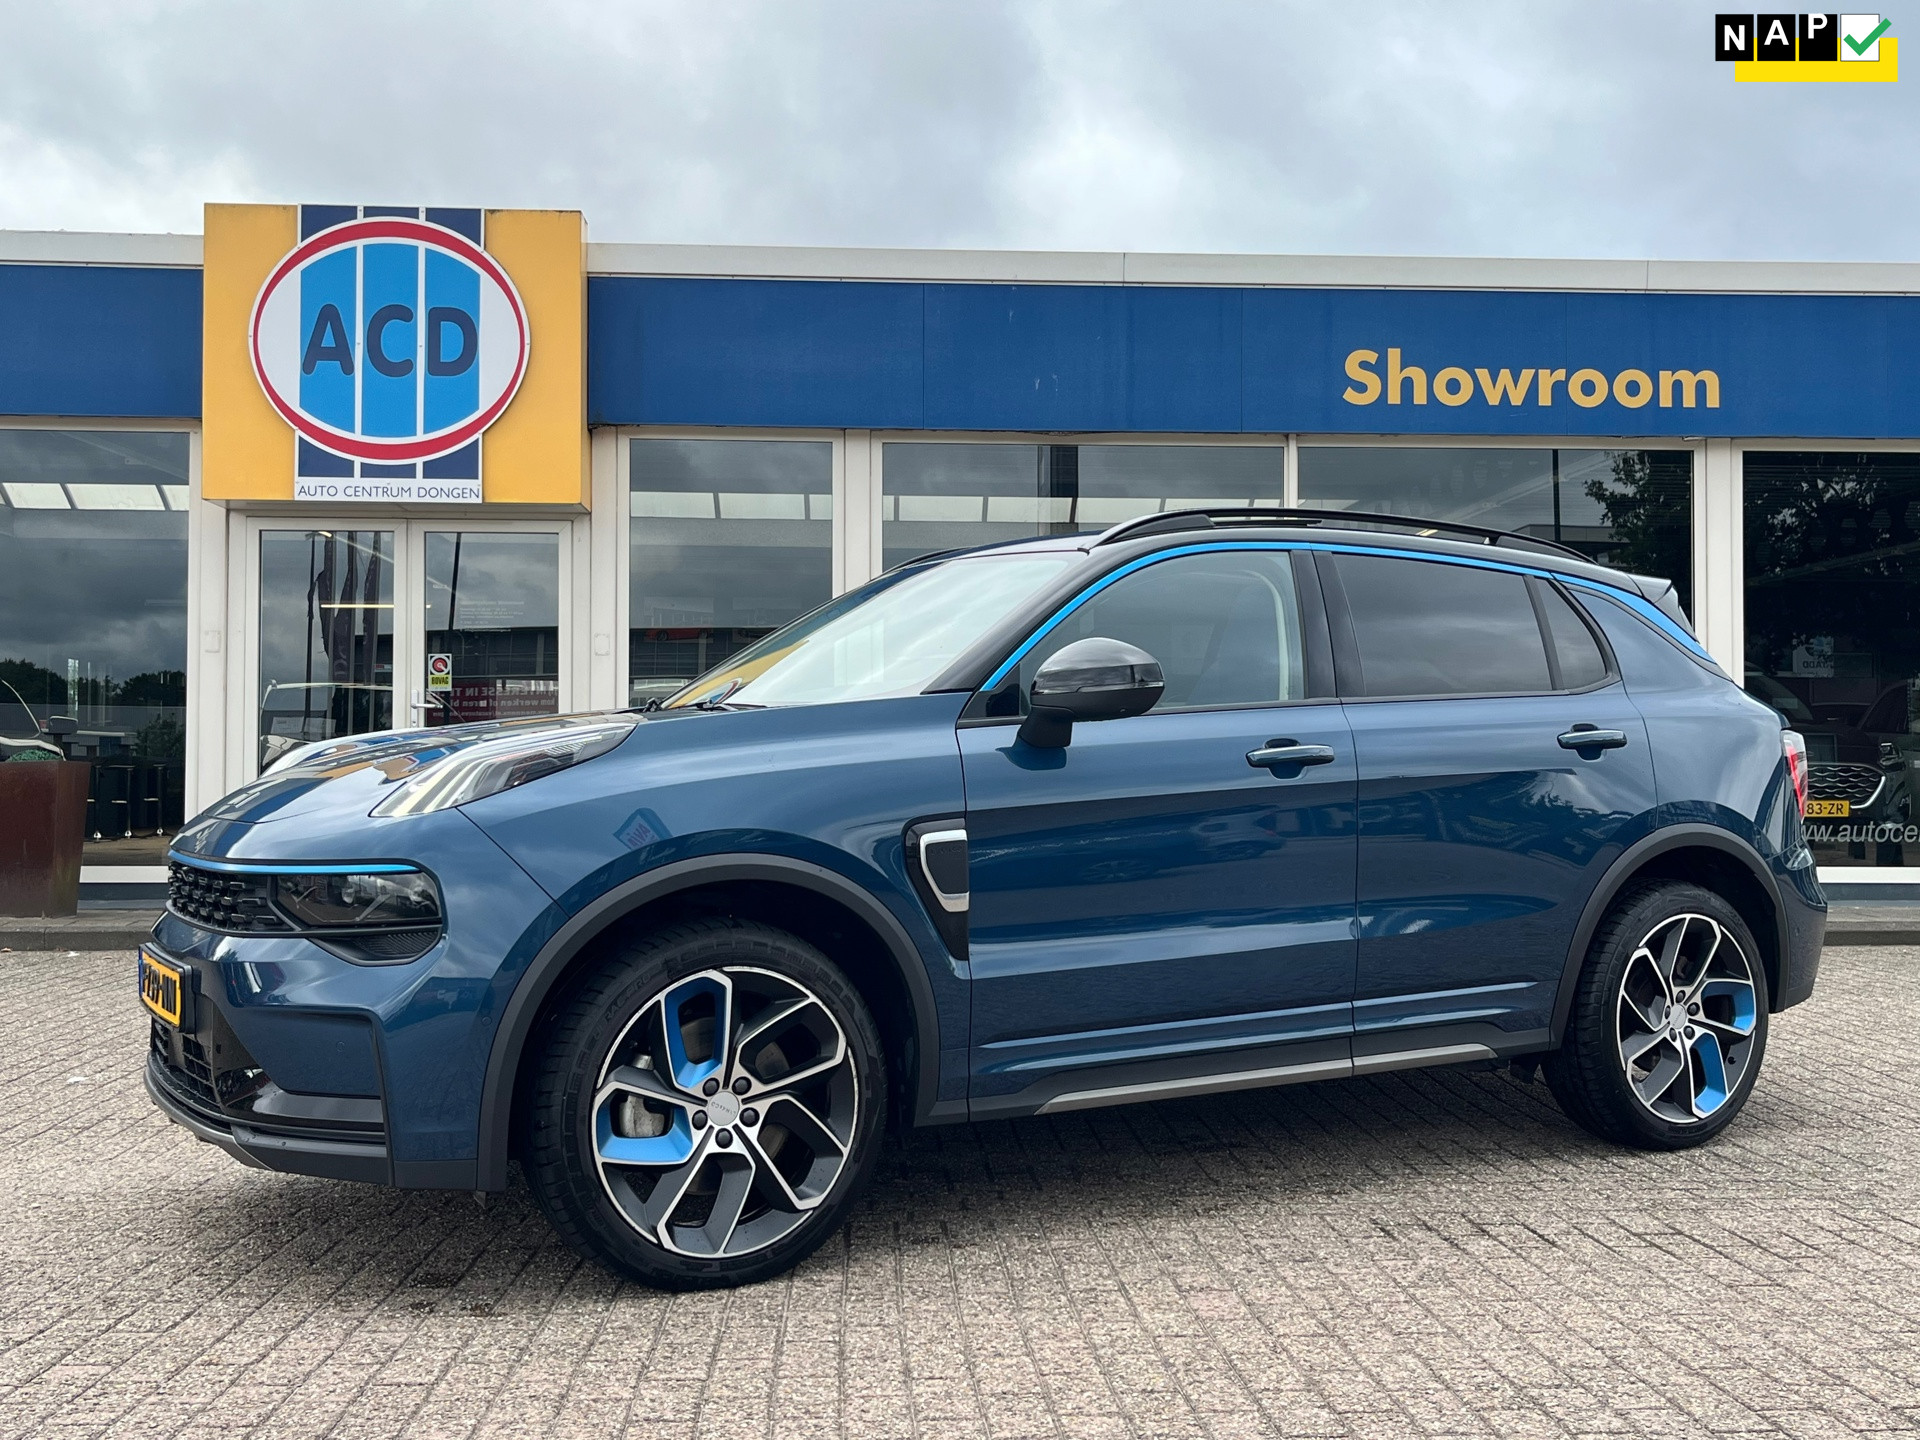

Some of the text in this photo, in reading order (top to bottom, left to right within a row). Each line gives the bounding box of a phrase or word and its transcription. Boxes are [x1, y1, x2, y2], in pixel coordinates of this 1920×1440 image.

[302, 303, 478, 378] ACD
[1342, 347, 1720, 409] Showroom
[298, 485, 480, 499] AUTO CENTRUM DONGEN
[431, 676, 449, 685] BOVAG
